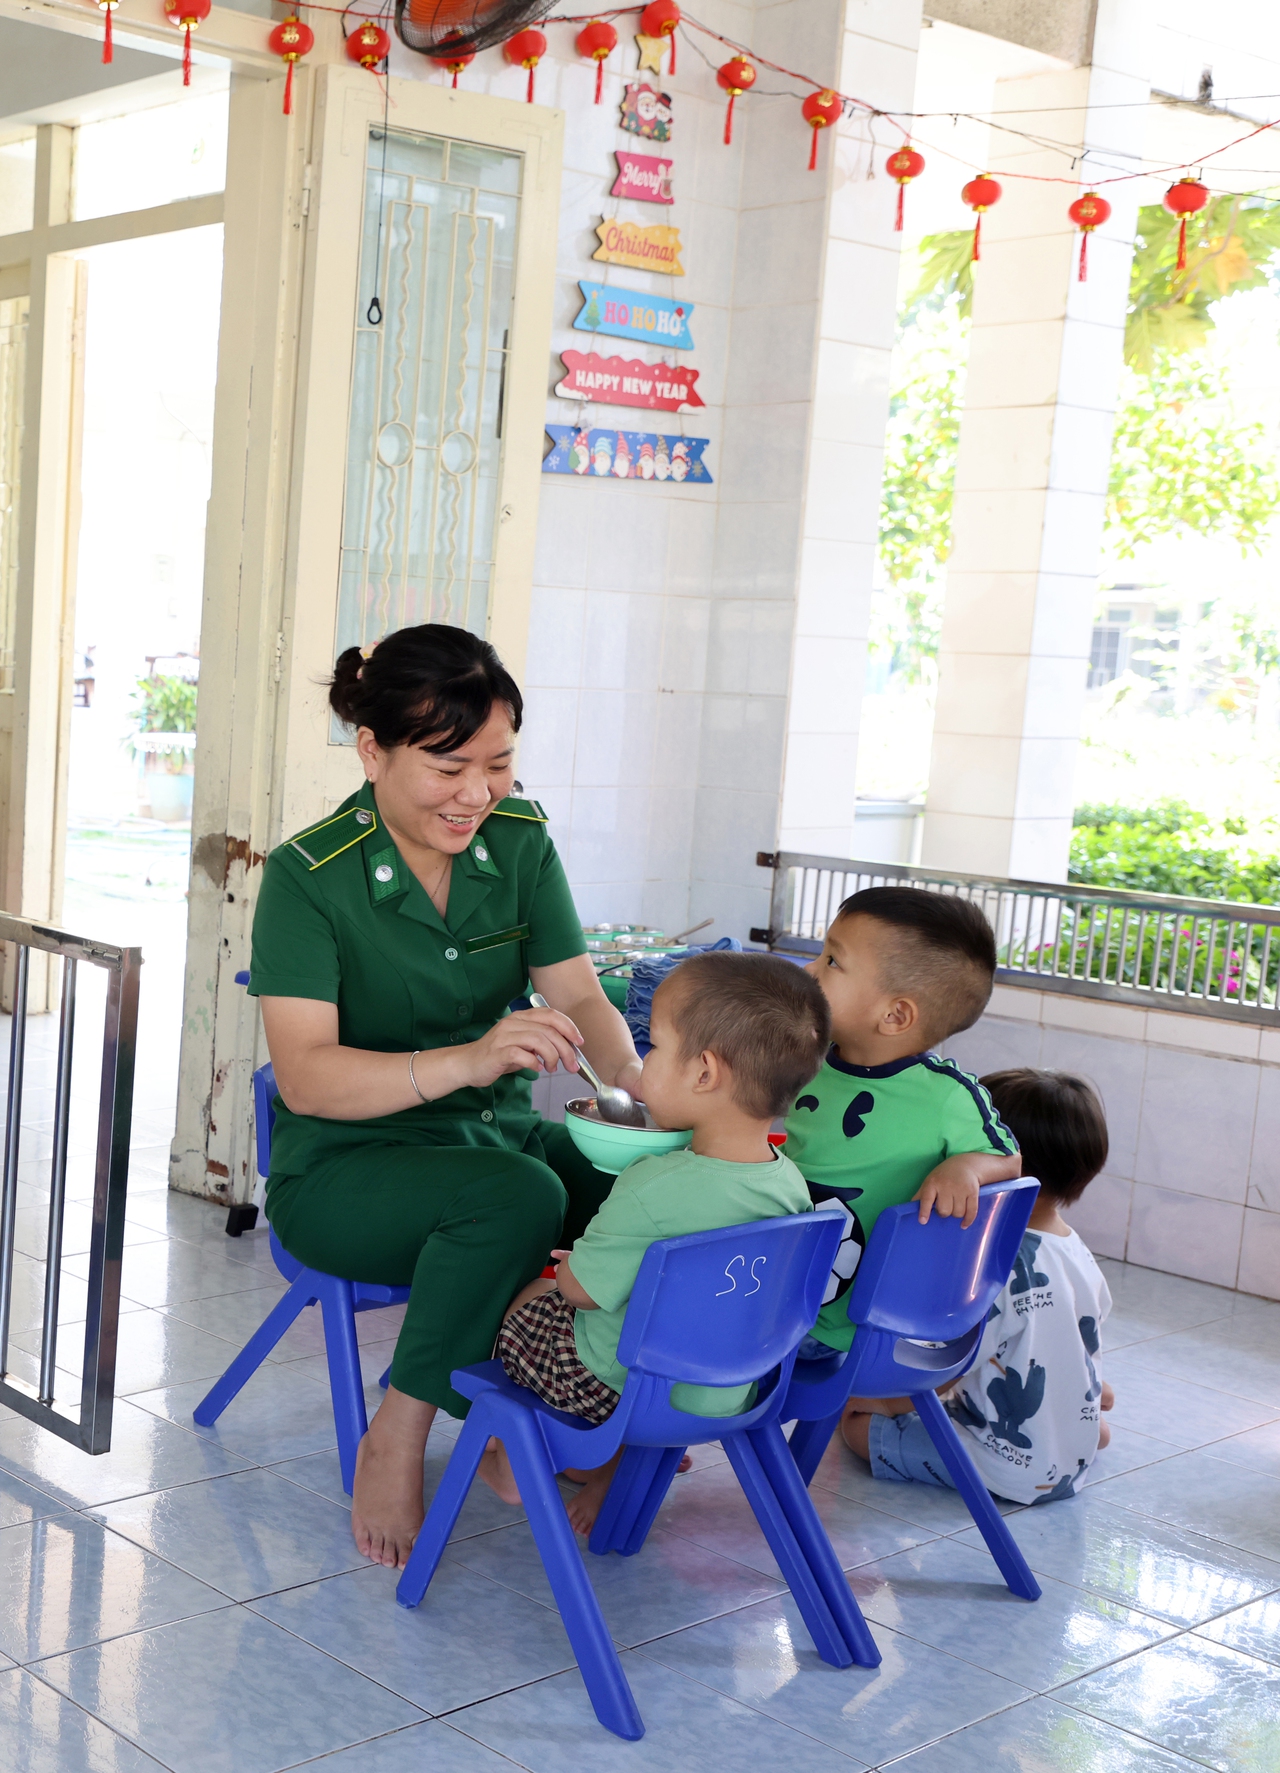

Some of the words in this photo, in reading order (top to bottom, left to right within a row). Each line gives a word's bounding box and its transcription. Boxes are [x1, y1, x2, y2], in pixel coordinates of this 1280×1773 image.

[622, 162, 661, 195] Merry
[605, 226, 675, 262] Christmas
[603, 301, 629, 326] HO
[631, 306, 656, 331] HO
[656, 310, 682, 336] HO
[575, 369, 620, 392] HAPPY
[622, 376, 653, 396] NEW
[655, 380, 688, 400] YEAR
[715, 1254, 767, 1297] SS
[1012, 1296, 1032, 1309] FEE
